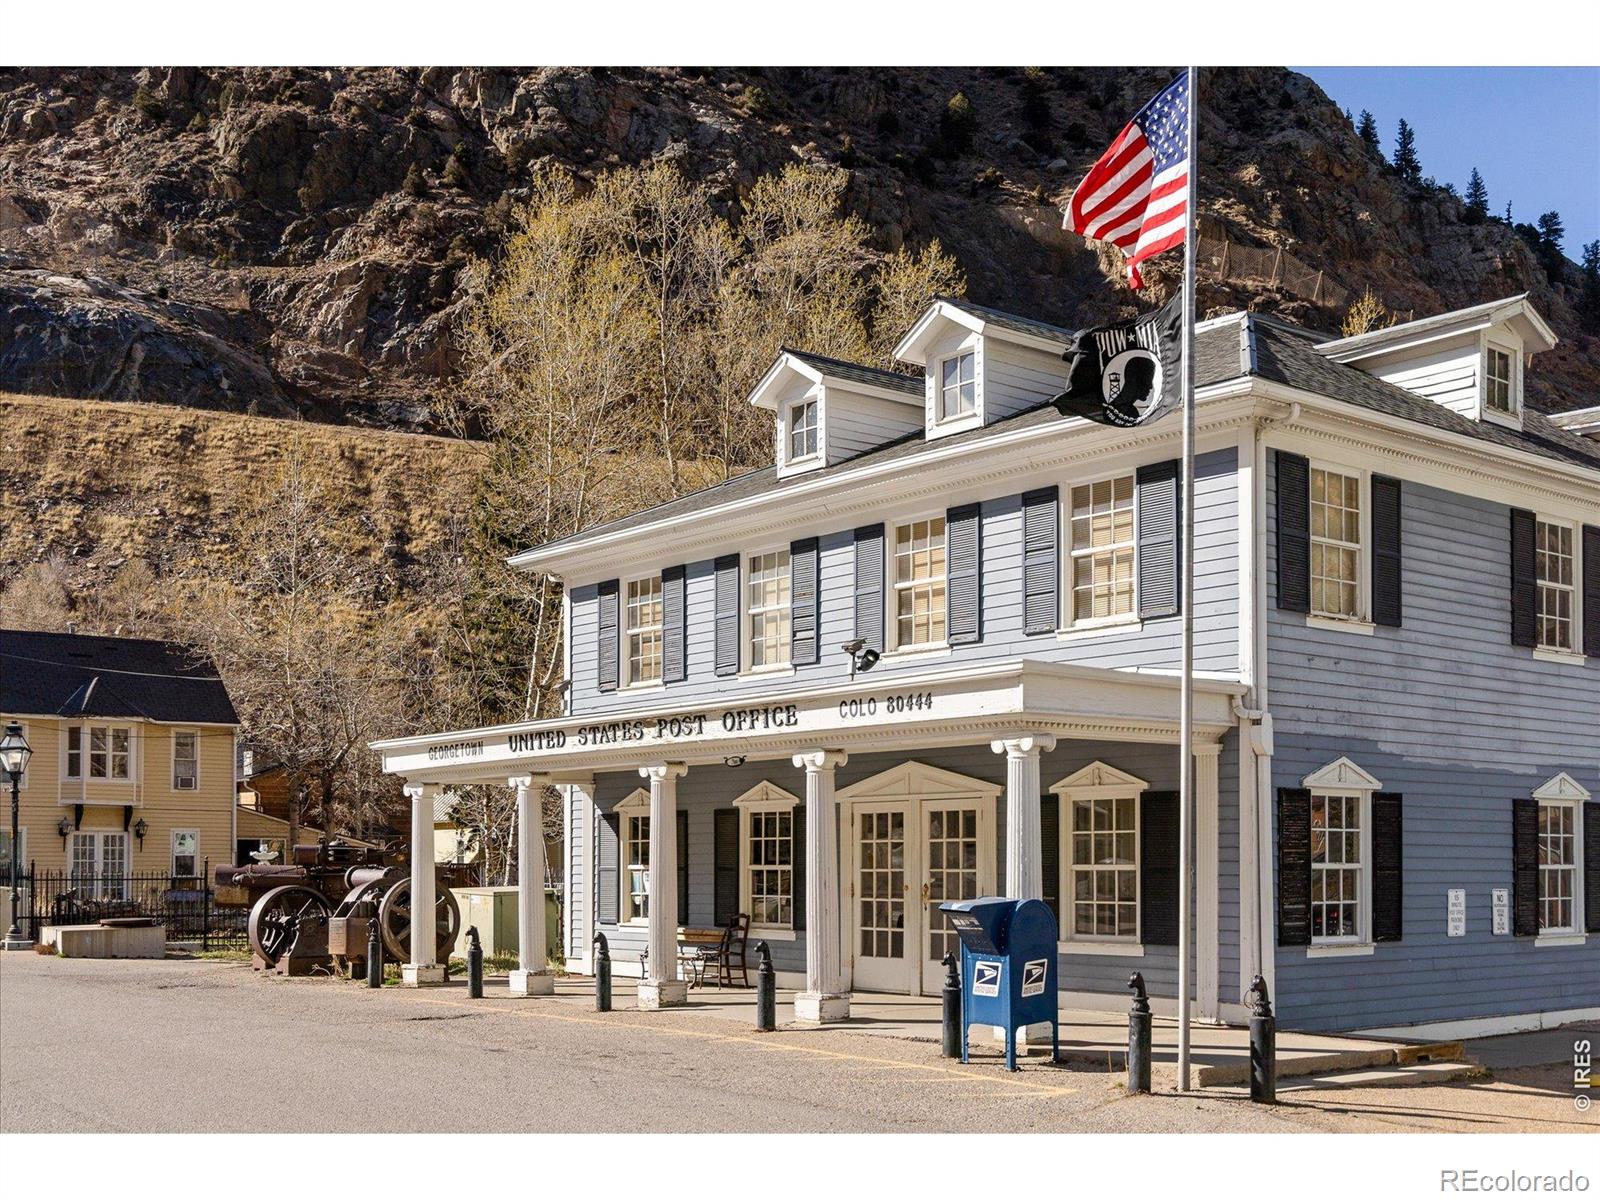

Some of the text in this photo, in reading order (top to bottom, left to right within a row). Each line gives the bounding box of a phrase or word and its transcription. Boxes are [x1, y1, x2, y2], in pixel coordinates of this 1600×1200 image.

[1095, 320, 1161, 374] POW MIA
[428, 692, 933, 761] GEORGETOWN UNITED STATES POST OFFICE COLO 80444
[1497, 894, 1504, 902] NO
